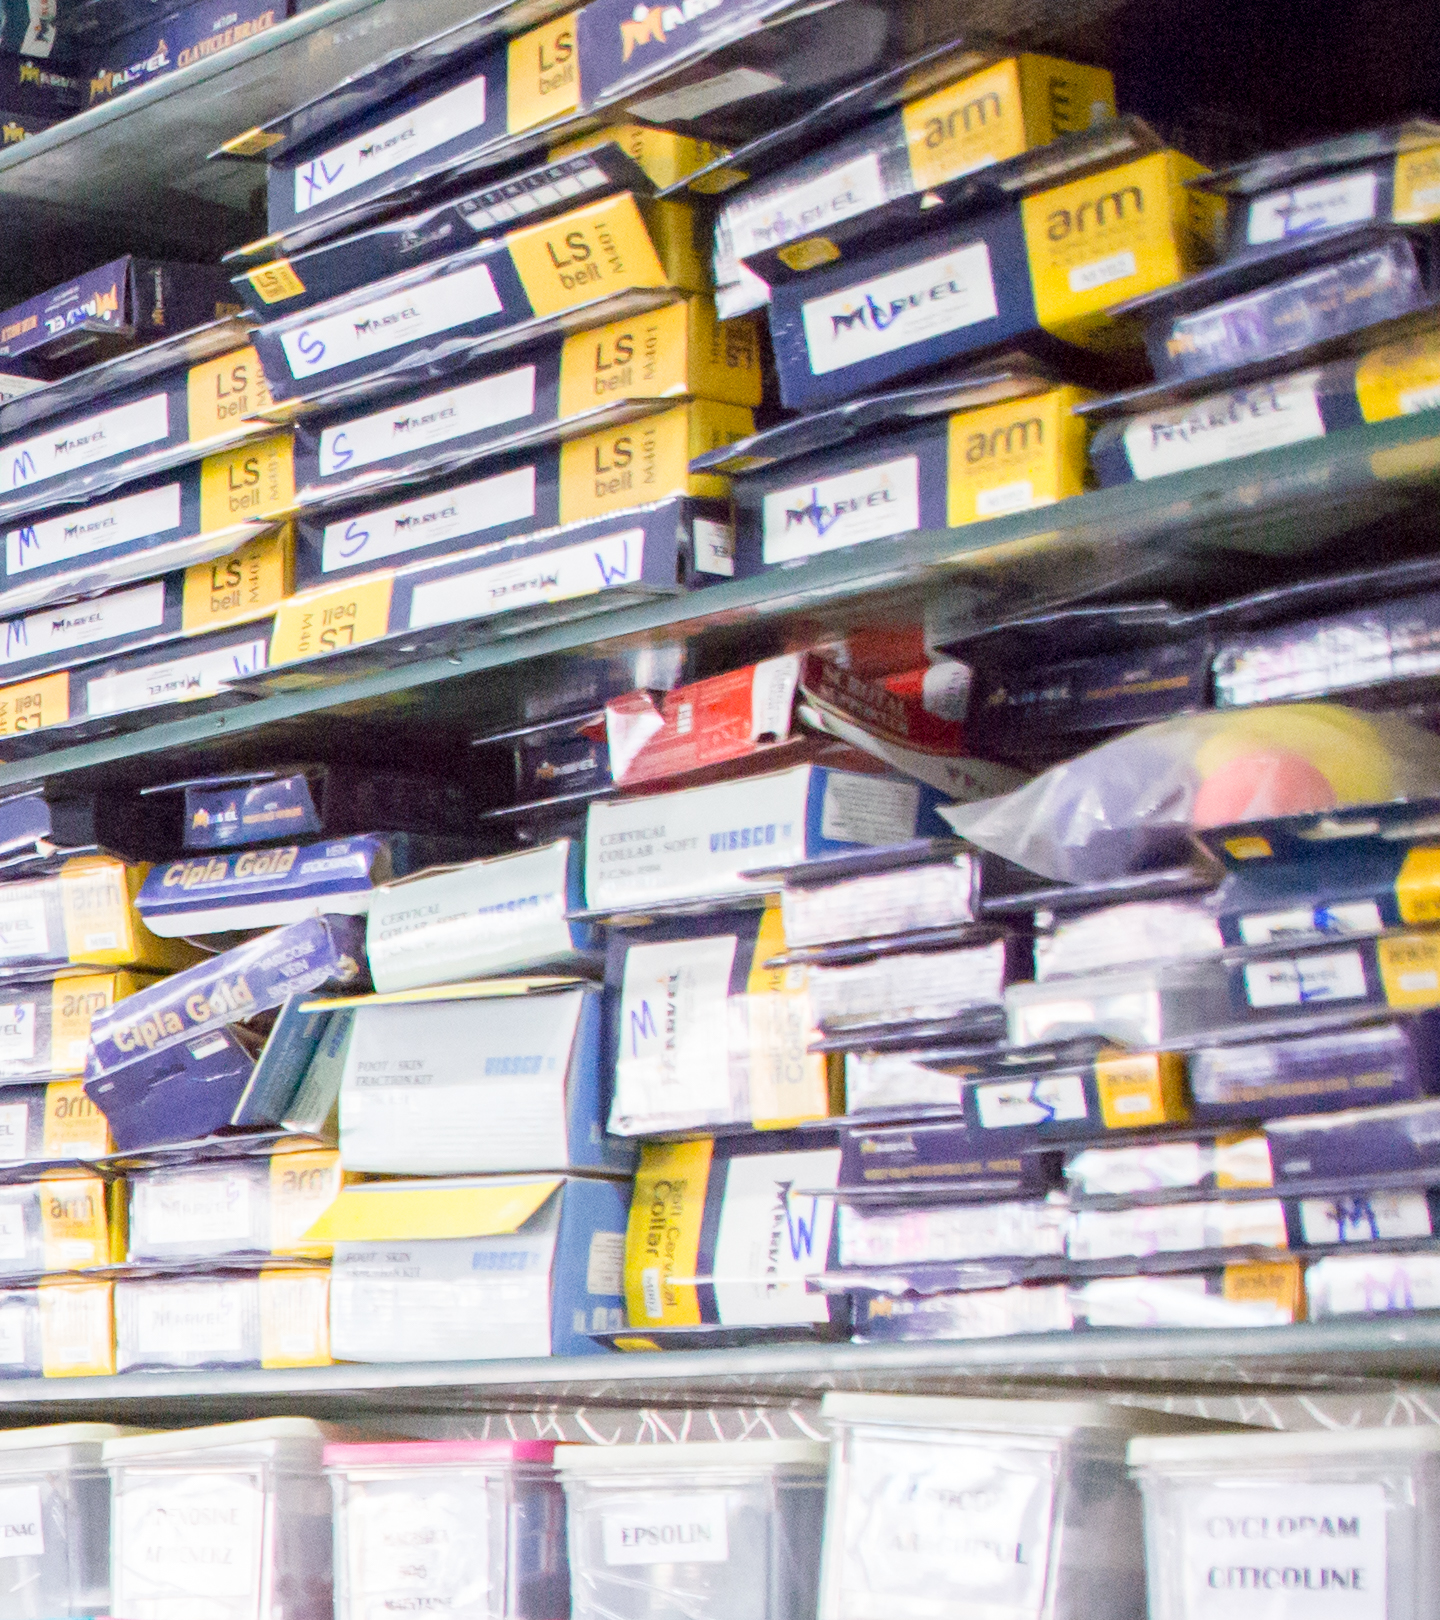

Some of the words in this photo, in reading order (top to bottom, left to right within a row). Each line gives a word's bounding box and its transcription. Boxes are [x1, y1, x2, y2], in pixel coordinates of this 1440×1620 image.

[232, 9, 275, 45] BRACE
[923, 90, 1002, 150] arm
[303, 157, 344, 197] XL
[1046, 184, 1146, 242] arm
[547, 231, 592, 270] LS
[354, 307, 420, 337] MARVEL
[297, 331, 325, 366] S
[595, 333, 635, 373] LS
[217, 366, 248, 398] LS
[392, 406, 458, 437] MARVEL
[965, 413, 1044, 463] arm
[55, 431, 106, 457] MARVEL
[595, 436, 632, 475] LS
[13, 451, 36, 484] M
[228, 457, 261, 490] LS
[64, 516, 117, 542] MARVEL
[395, 506, 459, 536] MARVEL
[339, 521, 368, 557] S
[210, 559, 242, 592] LS
[52, 610, 103, 636] MARVEL
[710, 823, 776, 853] VISSCO
[163, 858, 228, 889] Cipla
[234, 846, 298, 876] Gold
[112, 1011, 183, 1052] Cipla
[185, 976, 255, 1021] Gold
[630, 1001, 657, 1056] M
[399, 1059, 426, 1072] SKIN
[485, 1056, 542, 1076] VISSCO
[646, 1180, 673, 1258] Collar
[620, 1522, 713, 1547] EPSOLIN
[1207, 1564, 1368, 1591] CITICOLINE
